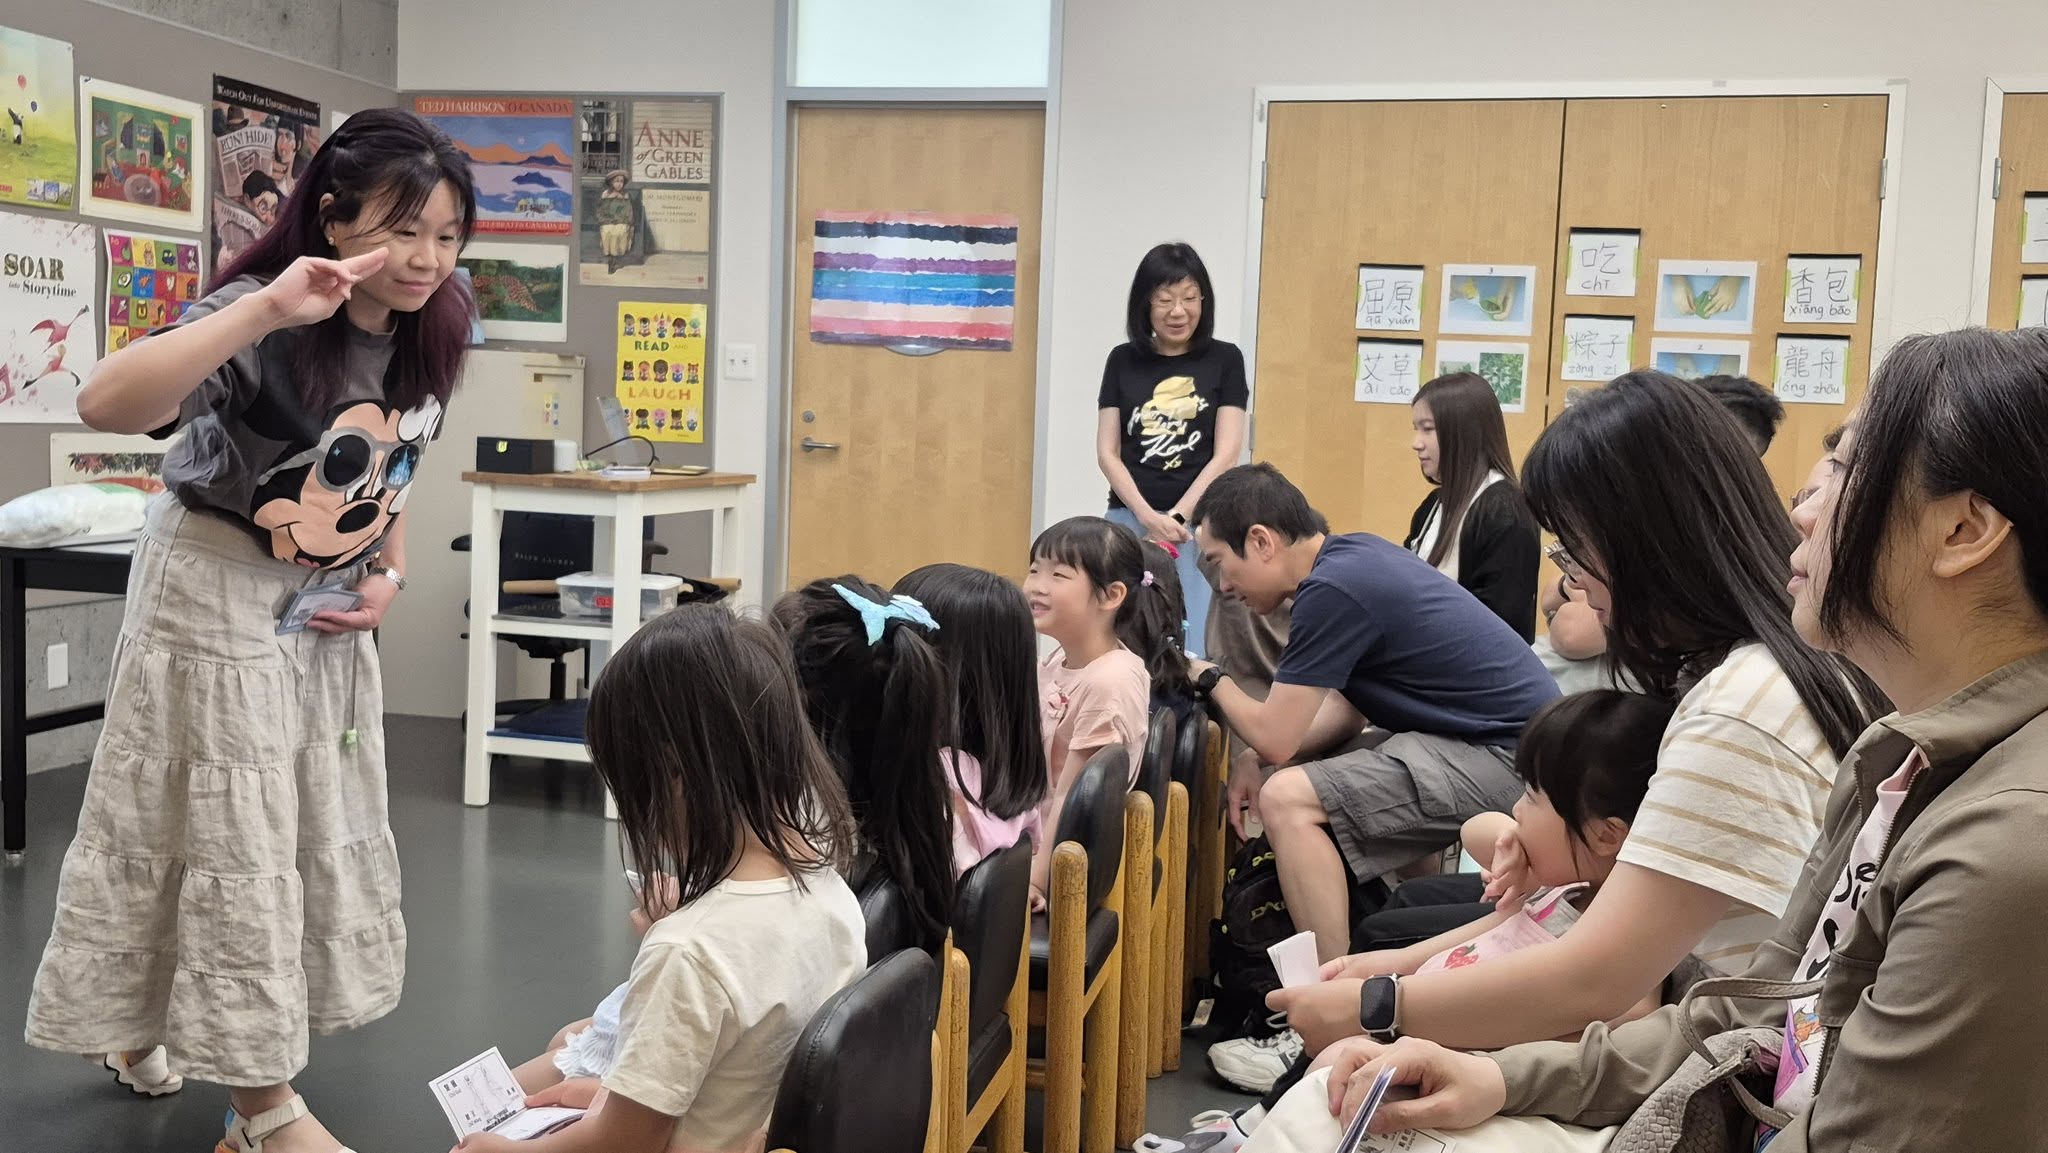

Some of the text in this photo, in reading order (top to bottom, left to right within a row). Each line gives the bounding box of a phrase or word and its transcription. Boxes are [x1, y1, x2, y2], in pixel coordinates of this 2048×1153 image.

[419, 101, 443, 113] TED
[446, 101, 505, 113] HARRISON
[522, 103, 570, 113] CANADA
[221, 133, 246, 151] RUN!
[635, 121, 704, 148] ANNE
[636, 149, 703, 166] of GREEN
[645, 164, 703, 180] GABLES
[4, 253, 64, 281] SOAR
[1581, 242, 1620, 274] 吃
[22, 280, 77, 299] Storytime
[1359, 279, 1413, 315] 屈原
[1791, 267, 1849, 304] 香包
[635, 341, 669, 351] READ
[1568, 330, 1624, 360] 粽子
[1362, 352, 1412, 385] 艾草
[1784, 345, 1838, 379] 龍舟
[629, 387, 691, 400] LAUGH
[1140, 430, 1201, 463] Karl
